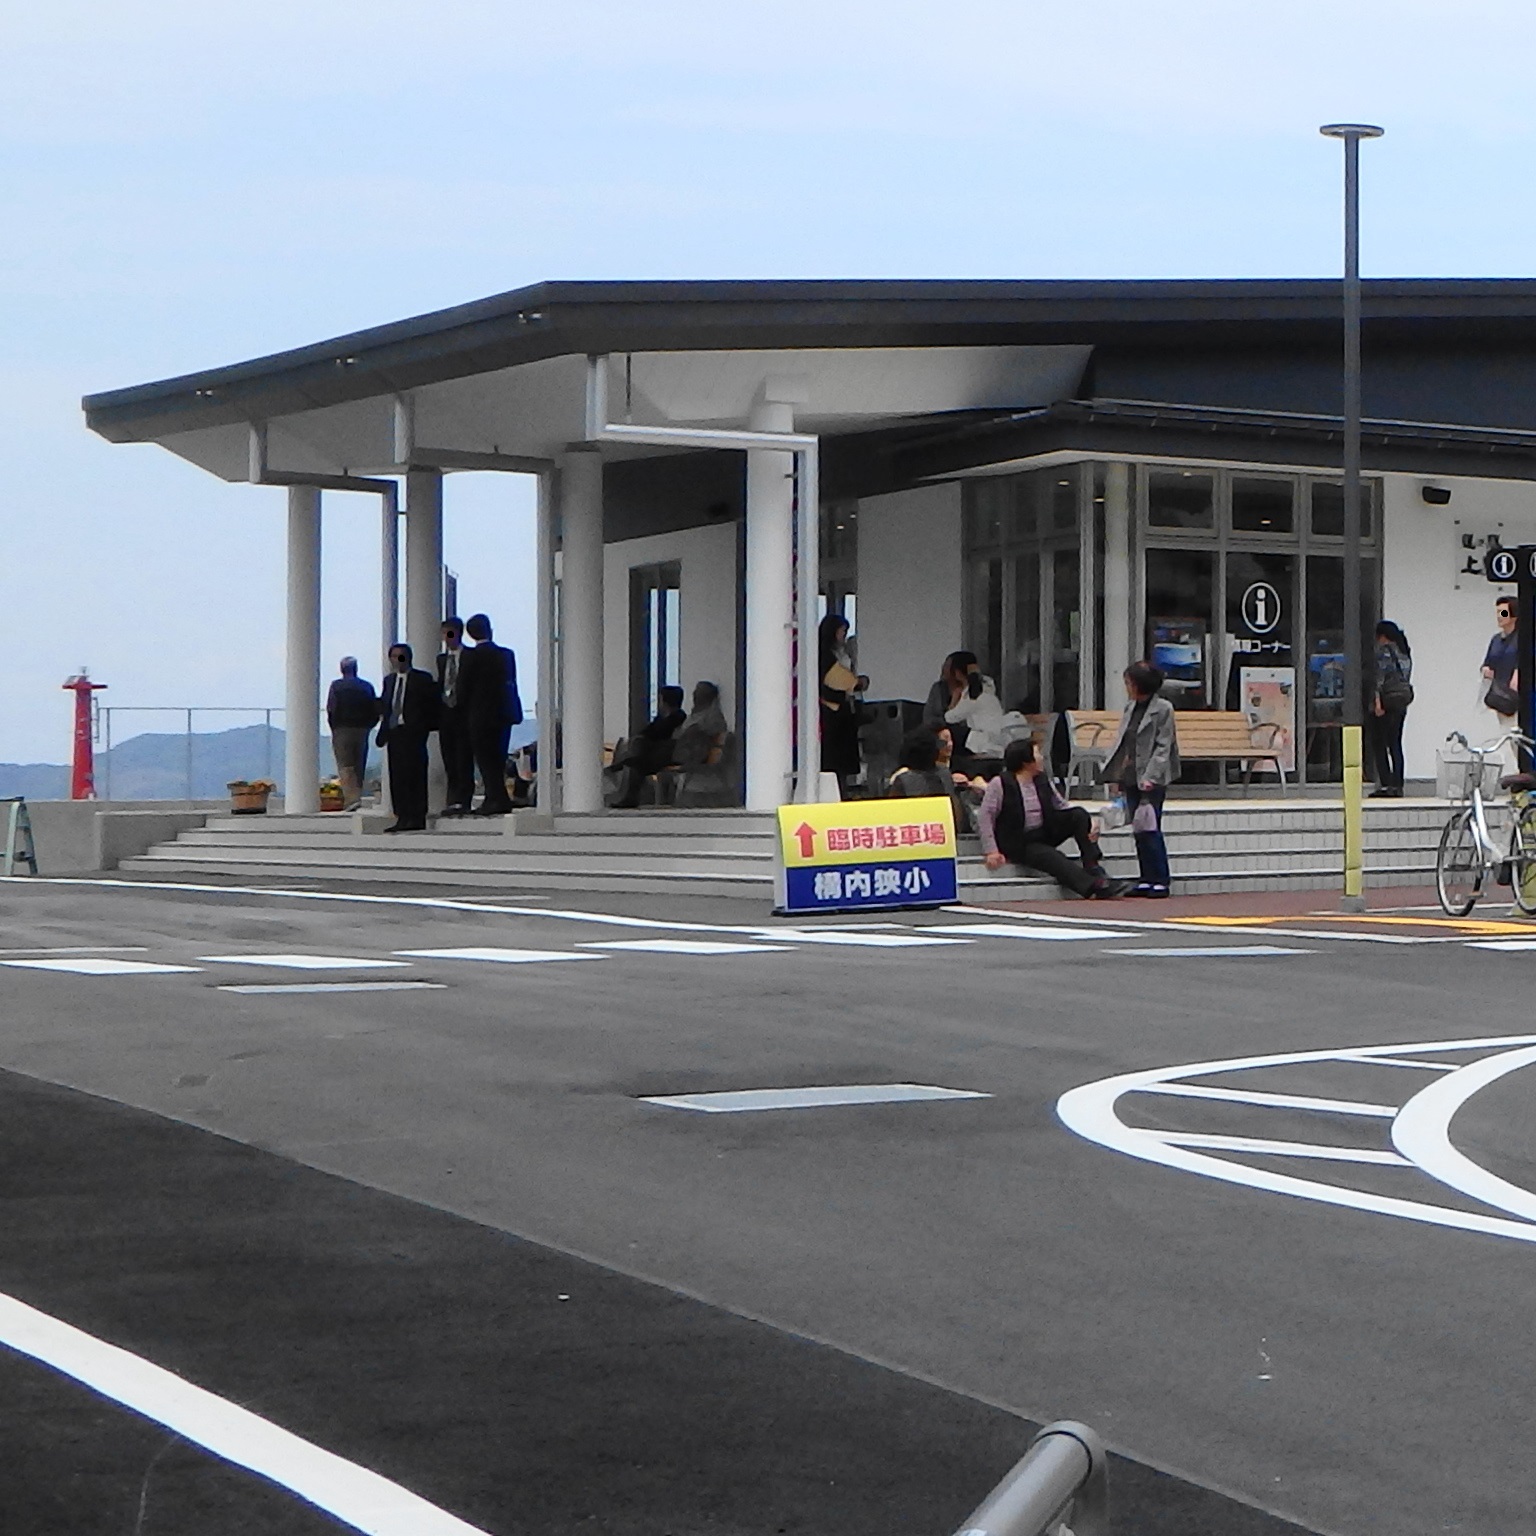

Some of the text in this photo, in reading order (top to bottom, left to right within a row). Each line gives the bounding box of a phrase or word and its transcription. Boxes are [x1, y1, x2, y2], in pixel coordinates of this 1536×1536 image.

[827, 823, 947, 852] 臨時駐車場
[814, 866, 931, 901] 構内狭小
